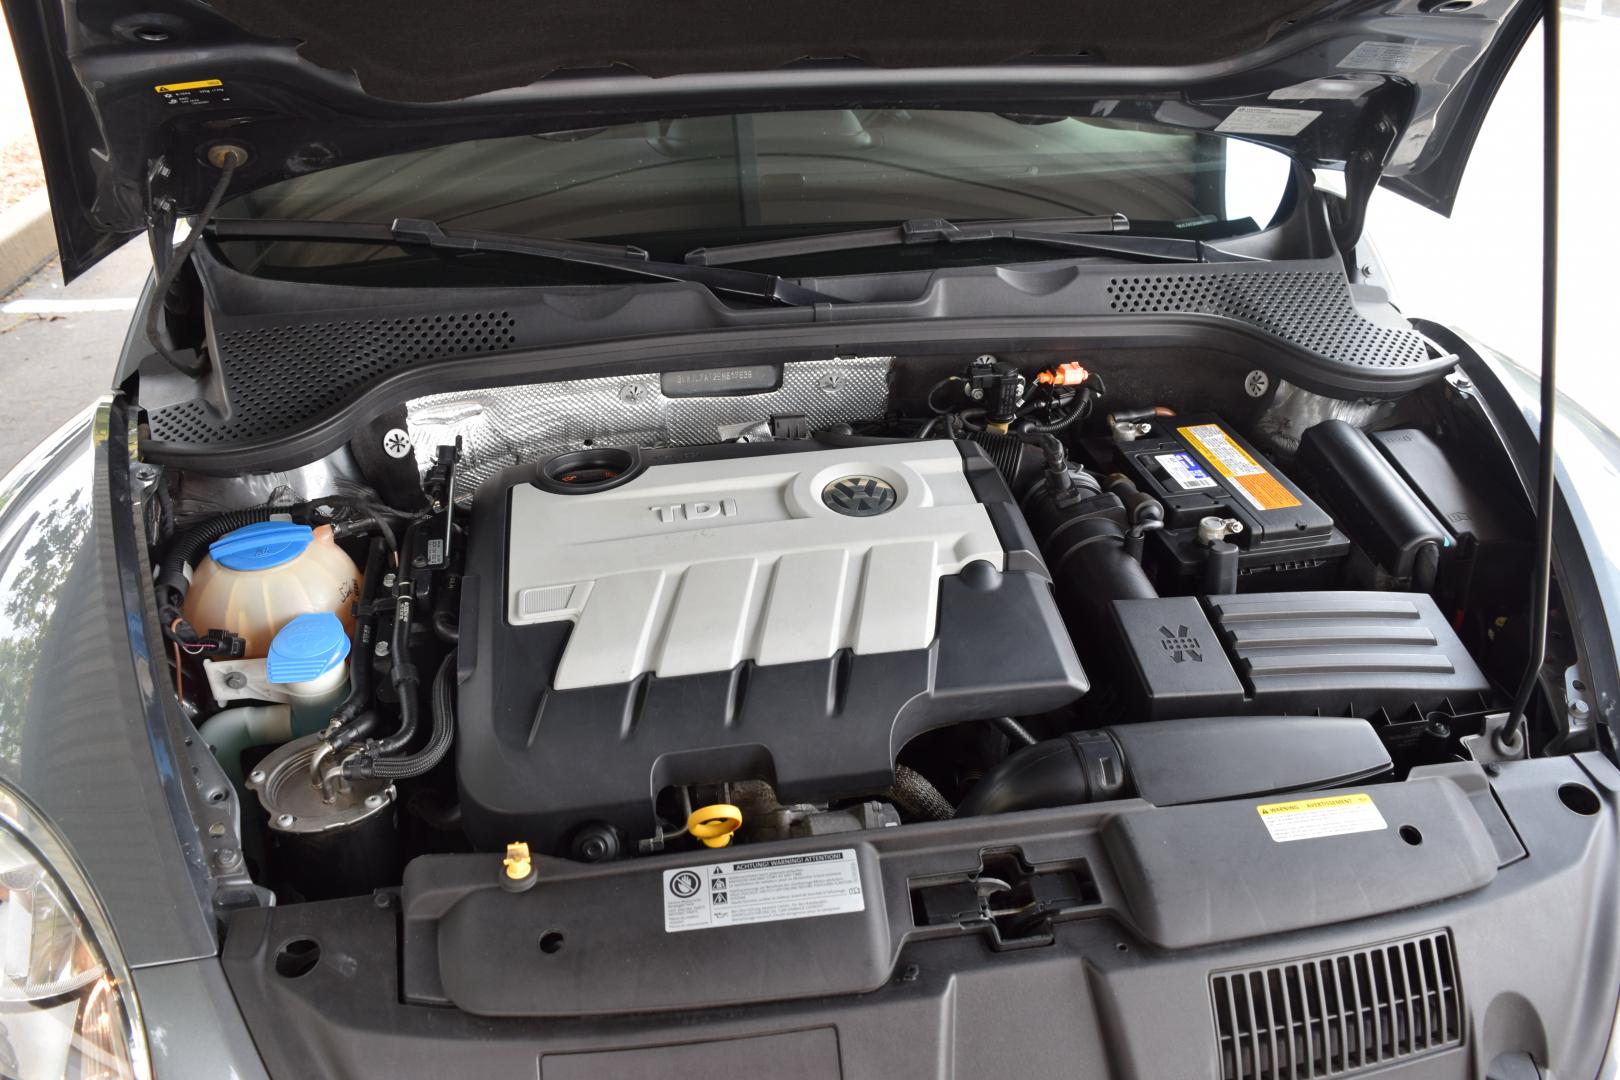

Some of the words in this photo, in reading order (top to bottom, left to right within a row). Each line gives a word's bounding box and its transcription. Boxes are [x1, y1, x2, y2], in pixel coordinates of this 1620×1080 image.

[649, 500, 736, 522] TDI
[736, 862, 770, 871] ACHTUNG!
[771, 858, 804, 867] WARNING!
[804, 853, 842, 863] ATTENTION!
